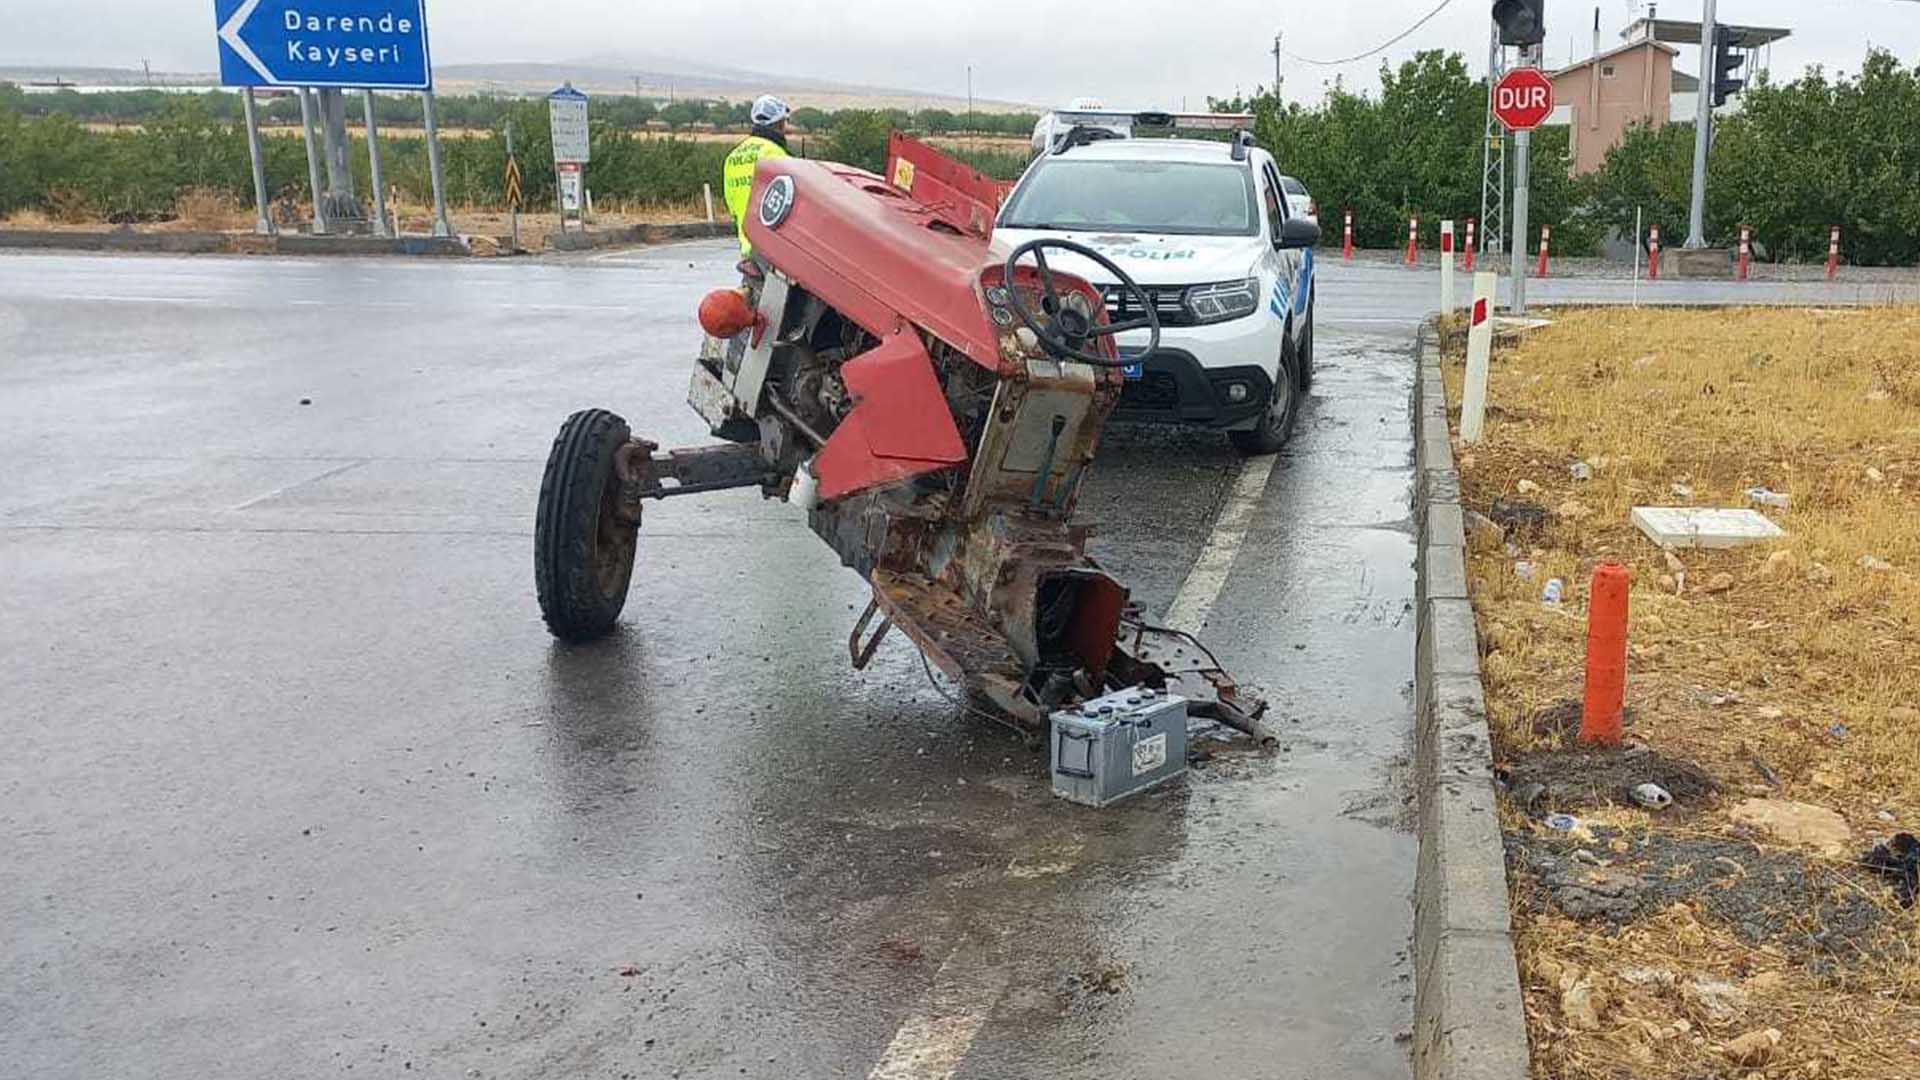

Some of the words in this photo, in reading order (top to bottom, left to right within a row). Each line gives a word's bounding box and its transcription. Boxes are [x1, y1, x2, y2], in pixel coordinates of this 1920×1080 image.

[284, 10, 412, 33] Darende
[287, 41, 400, 67] Kayseri
[1499, 87, 1546, 110] DUR
